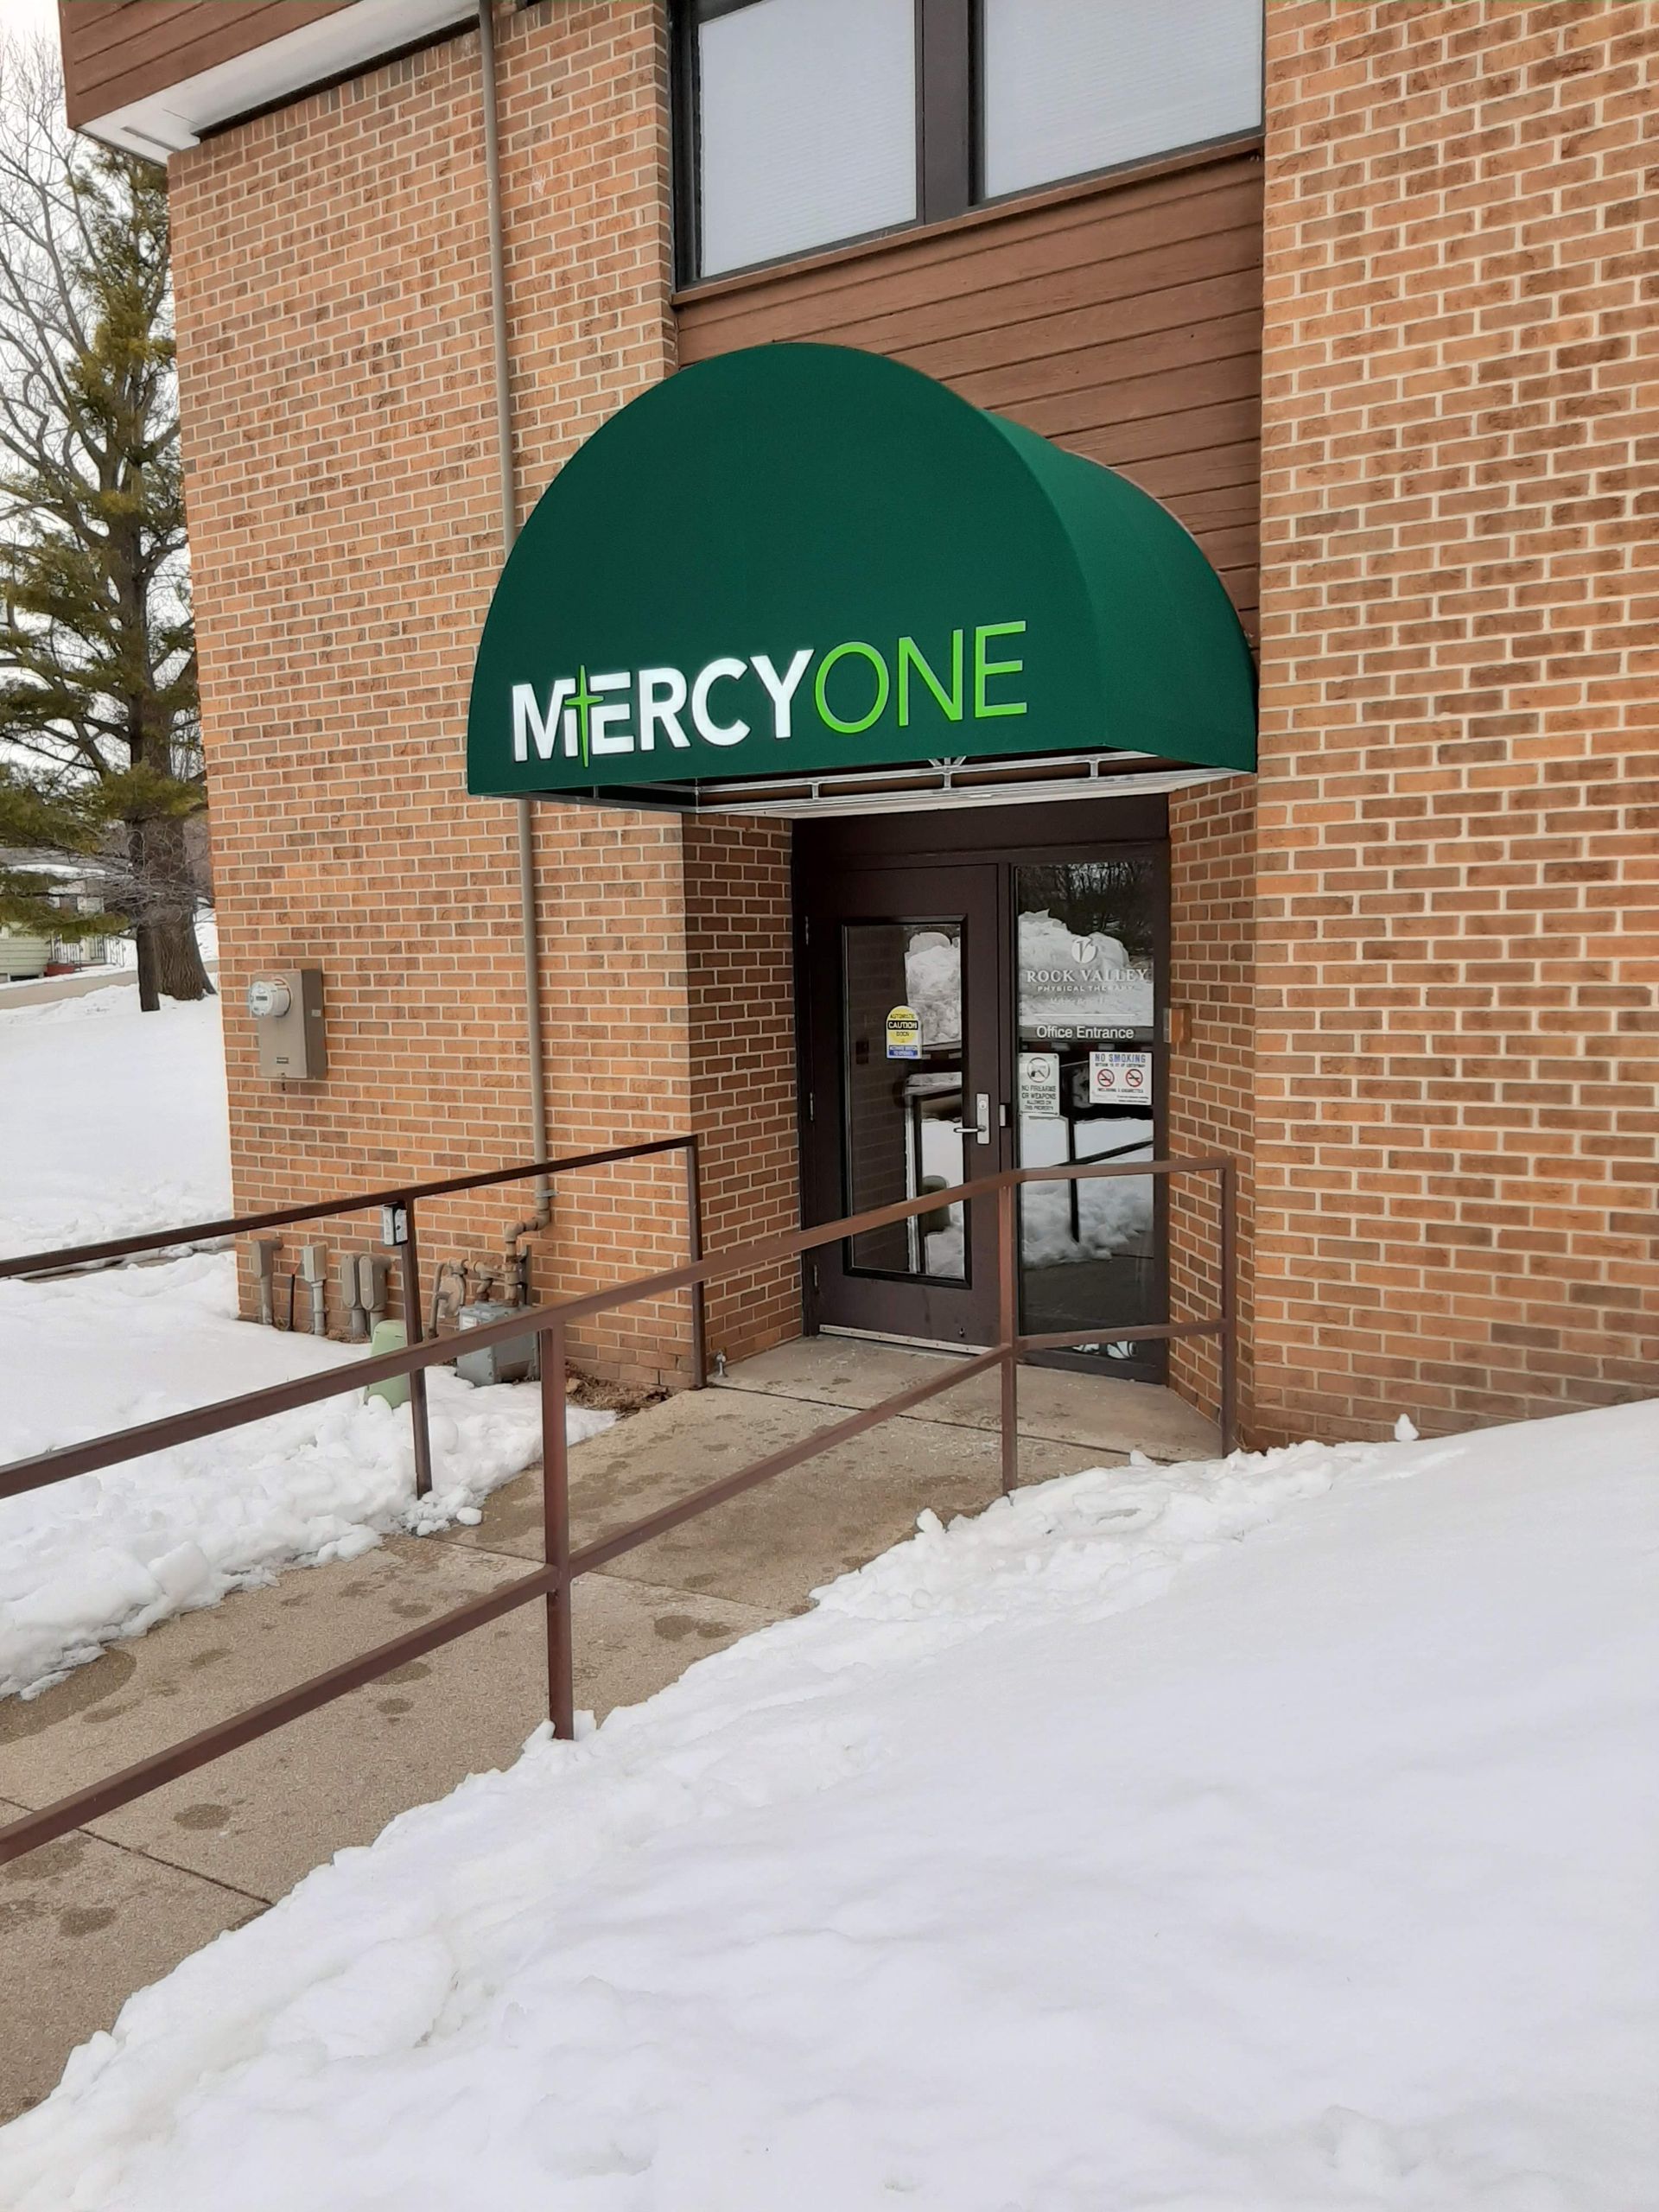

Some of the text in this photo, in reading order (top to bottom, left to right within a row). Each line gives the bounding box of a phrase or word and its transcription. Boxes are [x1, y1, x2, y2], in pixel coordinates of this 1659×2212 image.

[1027, 969, 1148, 982] ROCK VALLEY
[1037, 1026, 1135, 1039] Office Entrance
[1095, 1053, 1147, 1063] NO SMOKING
